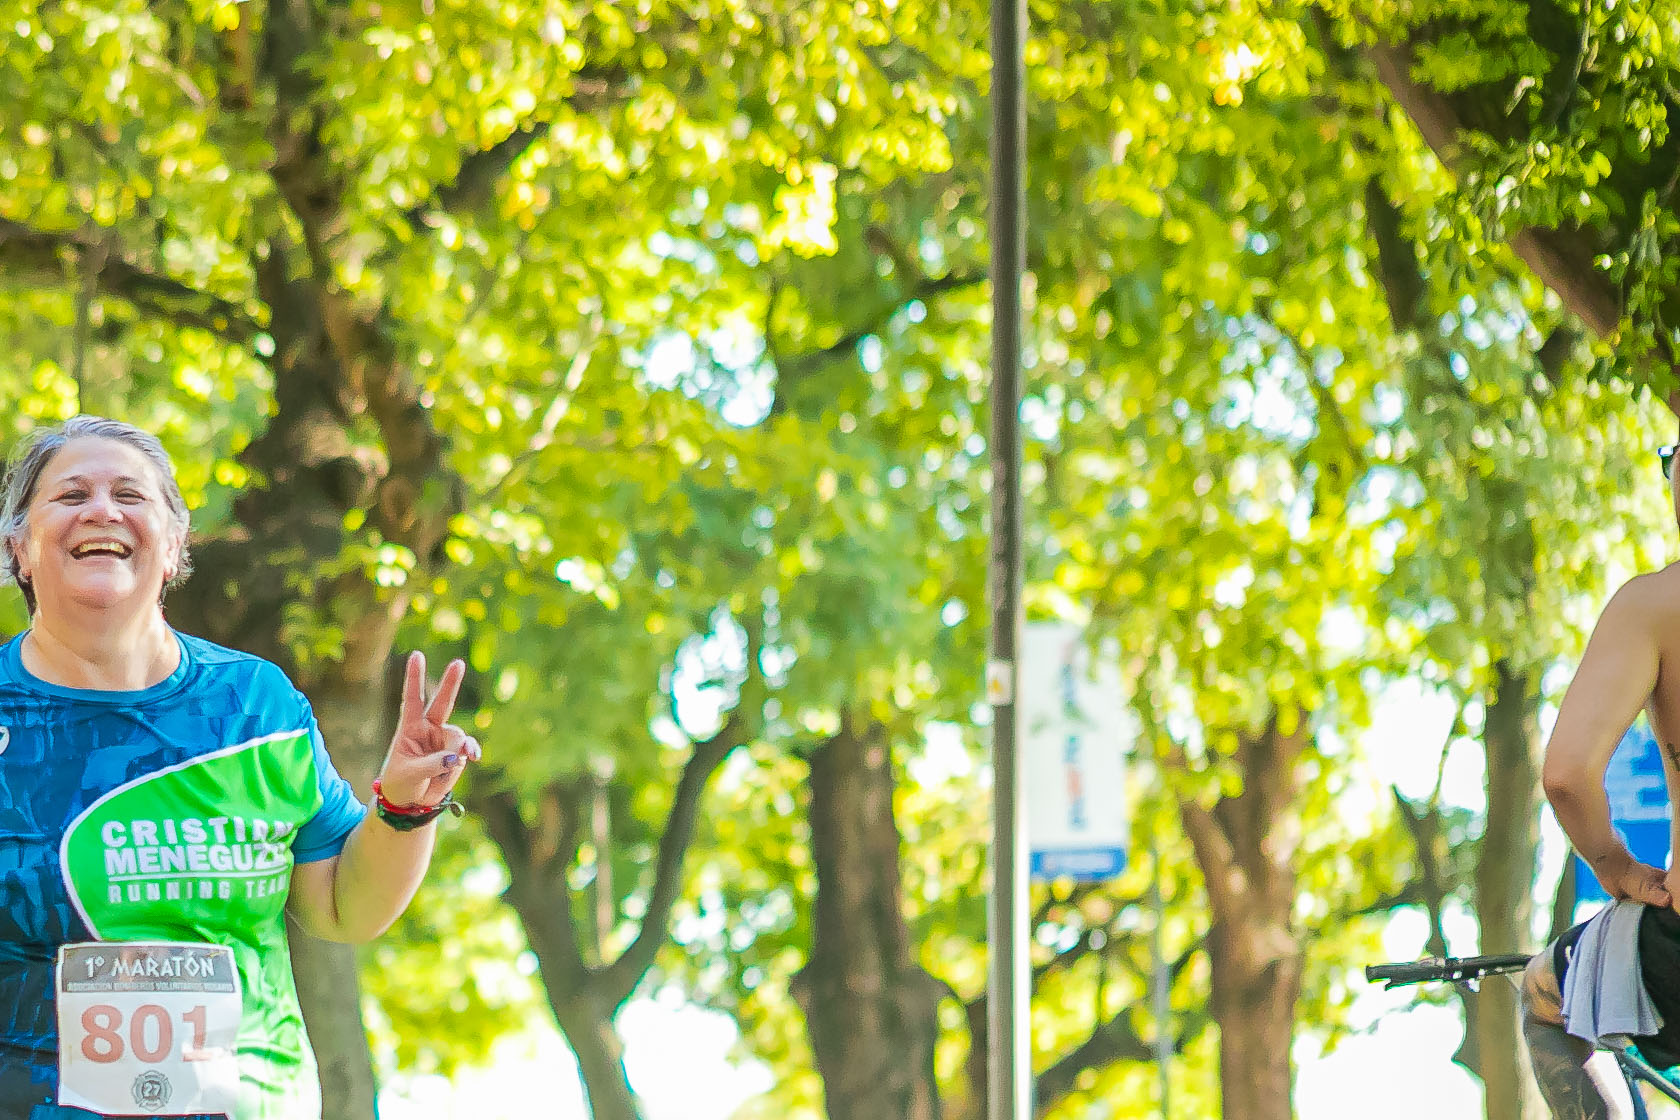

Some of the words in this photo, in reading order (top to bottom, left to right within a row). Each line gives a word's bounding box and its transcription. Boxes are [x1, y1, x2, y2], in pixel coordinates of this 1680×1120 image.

[108, 880, 231, 904] RUNNING
[246, 874, 287, 899] TEAM
[110, 950, 215, 978] MARATÓN
[80, 1003, 212, 1065] 801
